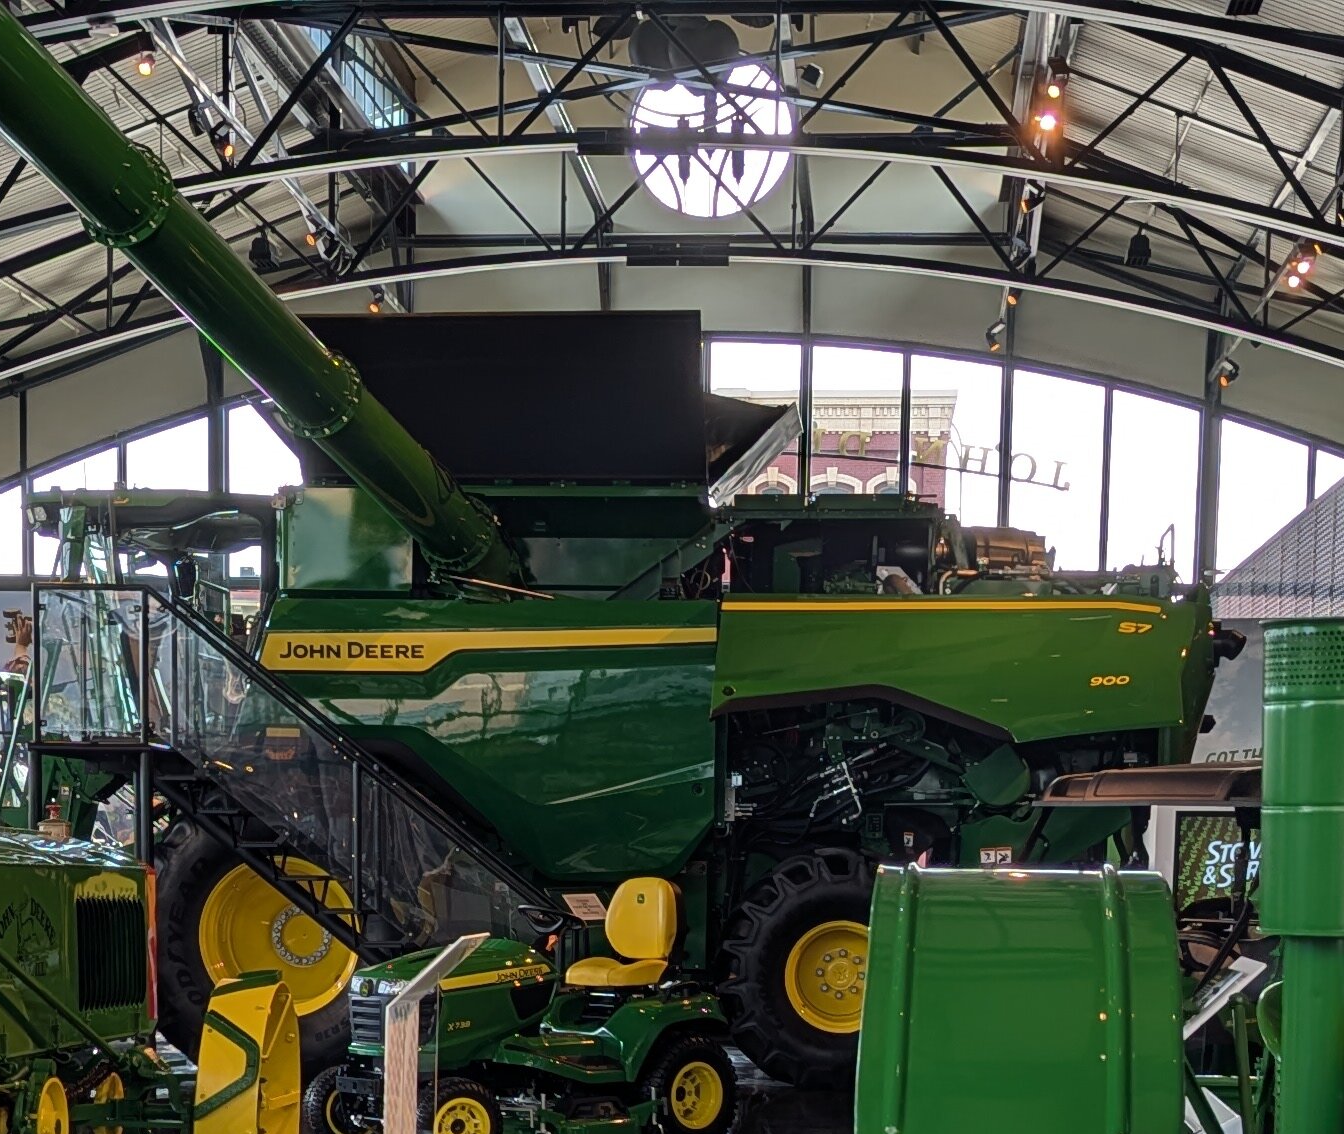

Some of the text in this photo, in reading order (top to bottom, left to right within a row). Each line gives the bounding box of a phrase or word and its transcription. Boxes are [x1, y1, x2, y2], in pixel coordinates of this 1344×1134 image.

[1118, 622, 1153, 633] S7
[280, 641, 425, 659] JOHN DEERE
[1090, 675, 1130, 686] 900
[1206, 750, 1239, 764] GOT
[496, 971, 519, 983] JOHN
